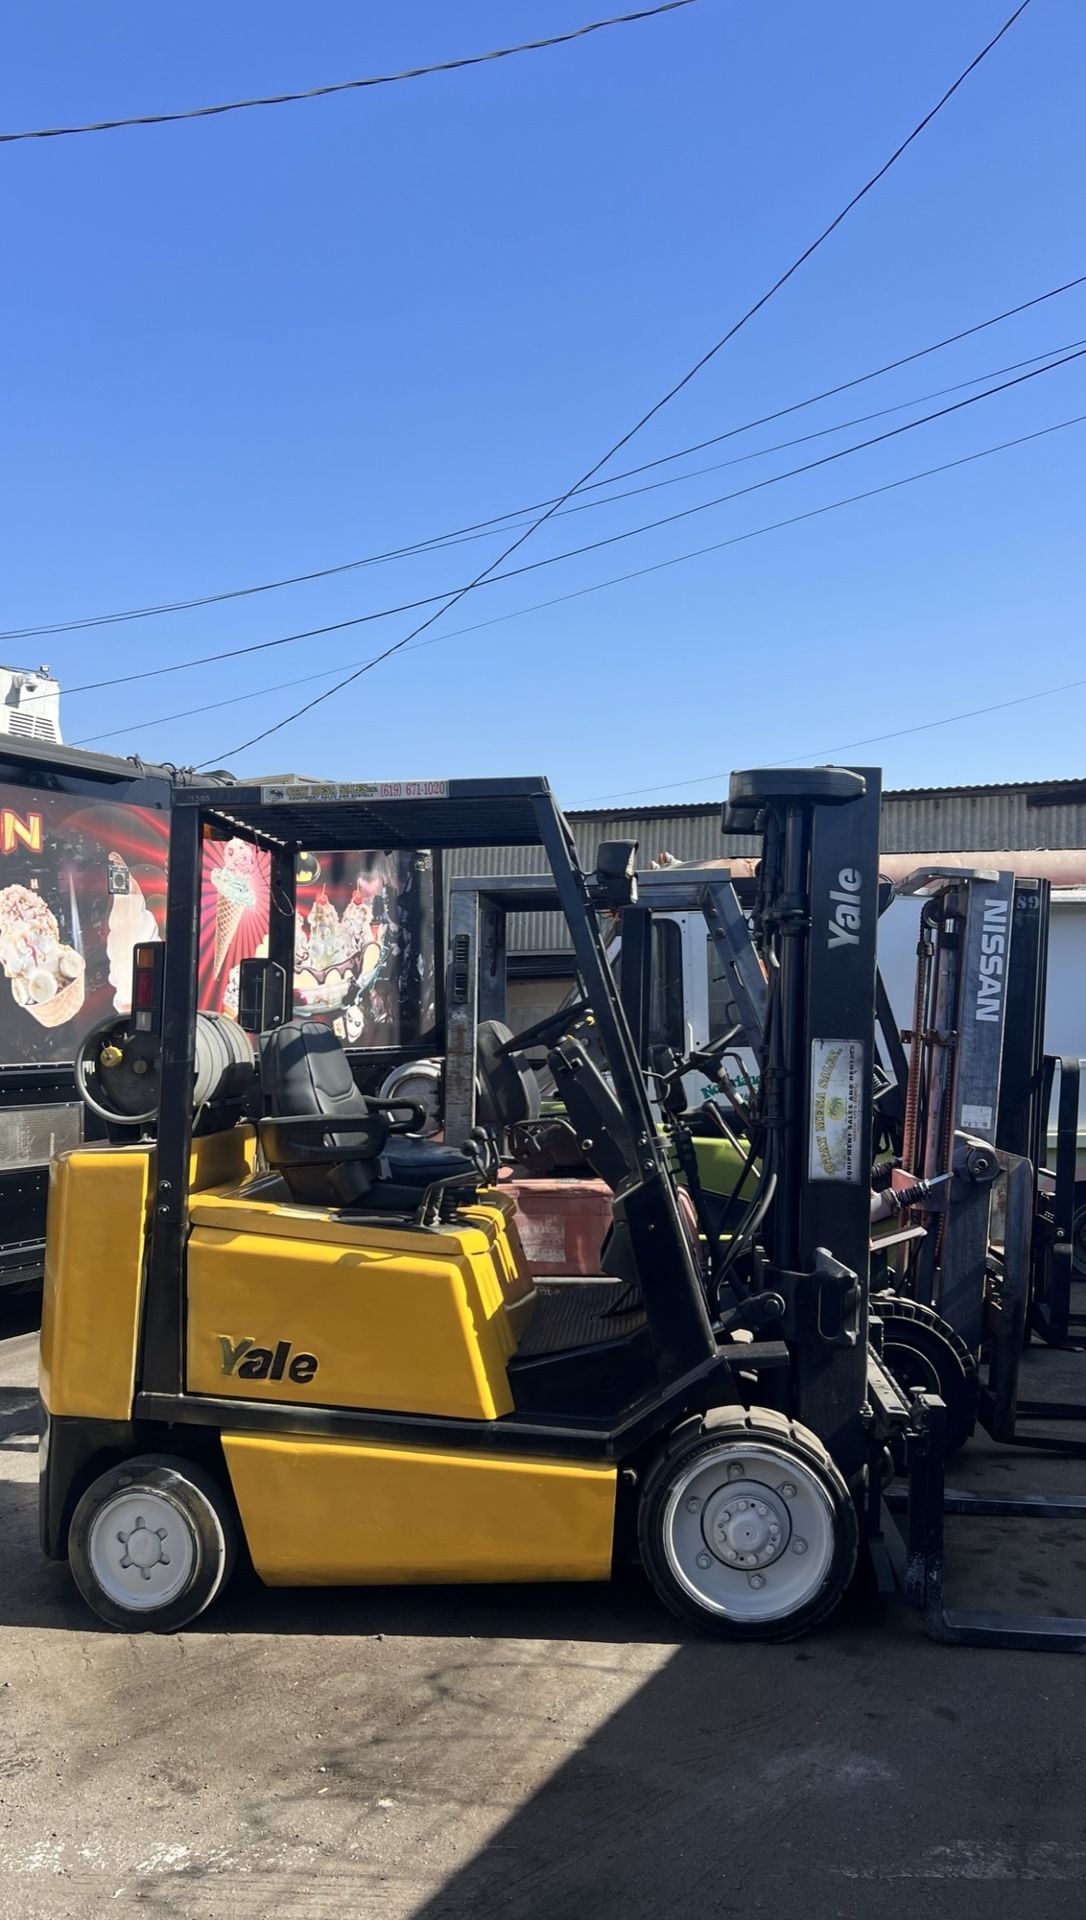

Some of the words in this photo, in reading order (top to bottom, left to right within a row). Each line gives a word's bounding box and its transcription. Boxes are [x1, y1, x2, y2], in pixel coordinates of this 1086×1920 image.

[380, 783, 402, 797] (619)
[406, 781, 445, 796] 671-1020
[827, 867, 863, 949] Yale
[975, 898, 1009, 1023] NISSAN
[815, 1092, 827, 1132] MESA
[815, 1136, 835, 1174] OTAY
[217, 1334, 319, 1385] Yale
